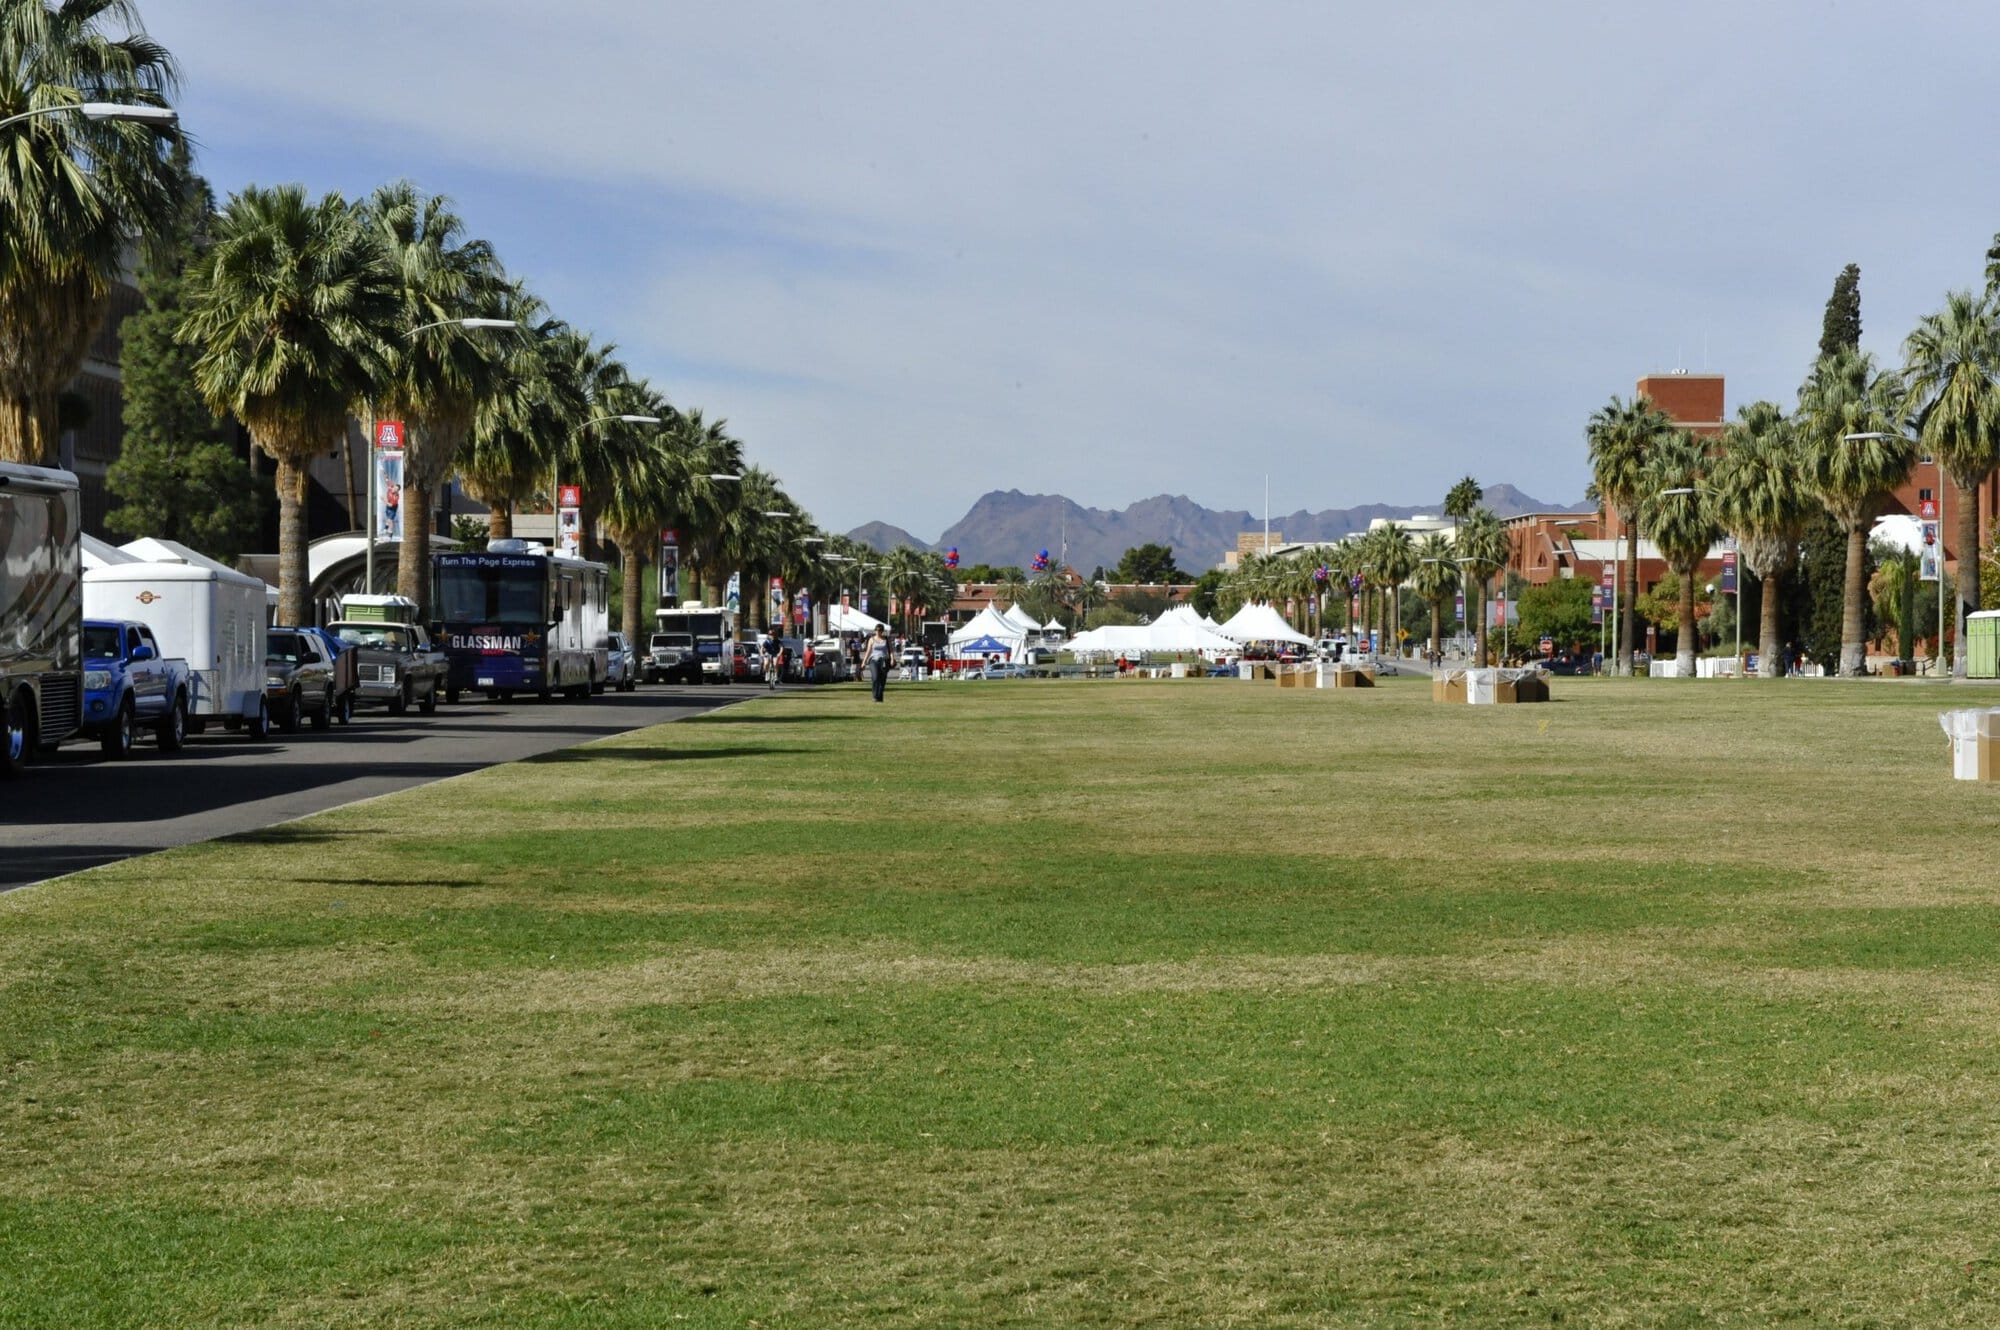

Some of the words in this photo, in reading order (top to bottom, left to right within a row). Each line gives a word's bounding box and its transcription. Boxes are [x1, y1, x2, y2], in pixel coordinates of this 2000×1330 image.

[442, 557, 459, 566] Turn
[461, 557, 477, 566] The
[479, 557, 500, 567] Page
[502, 557, 536, 567] Express
[452, 635, 521, 649] GLASSMAN
